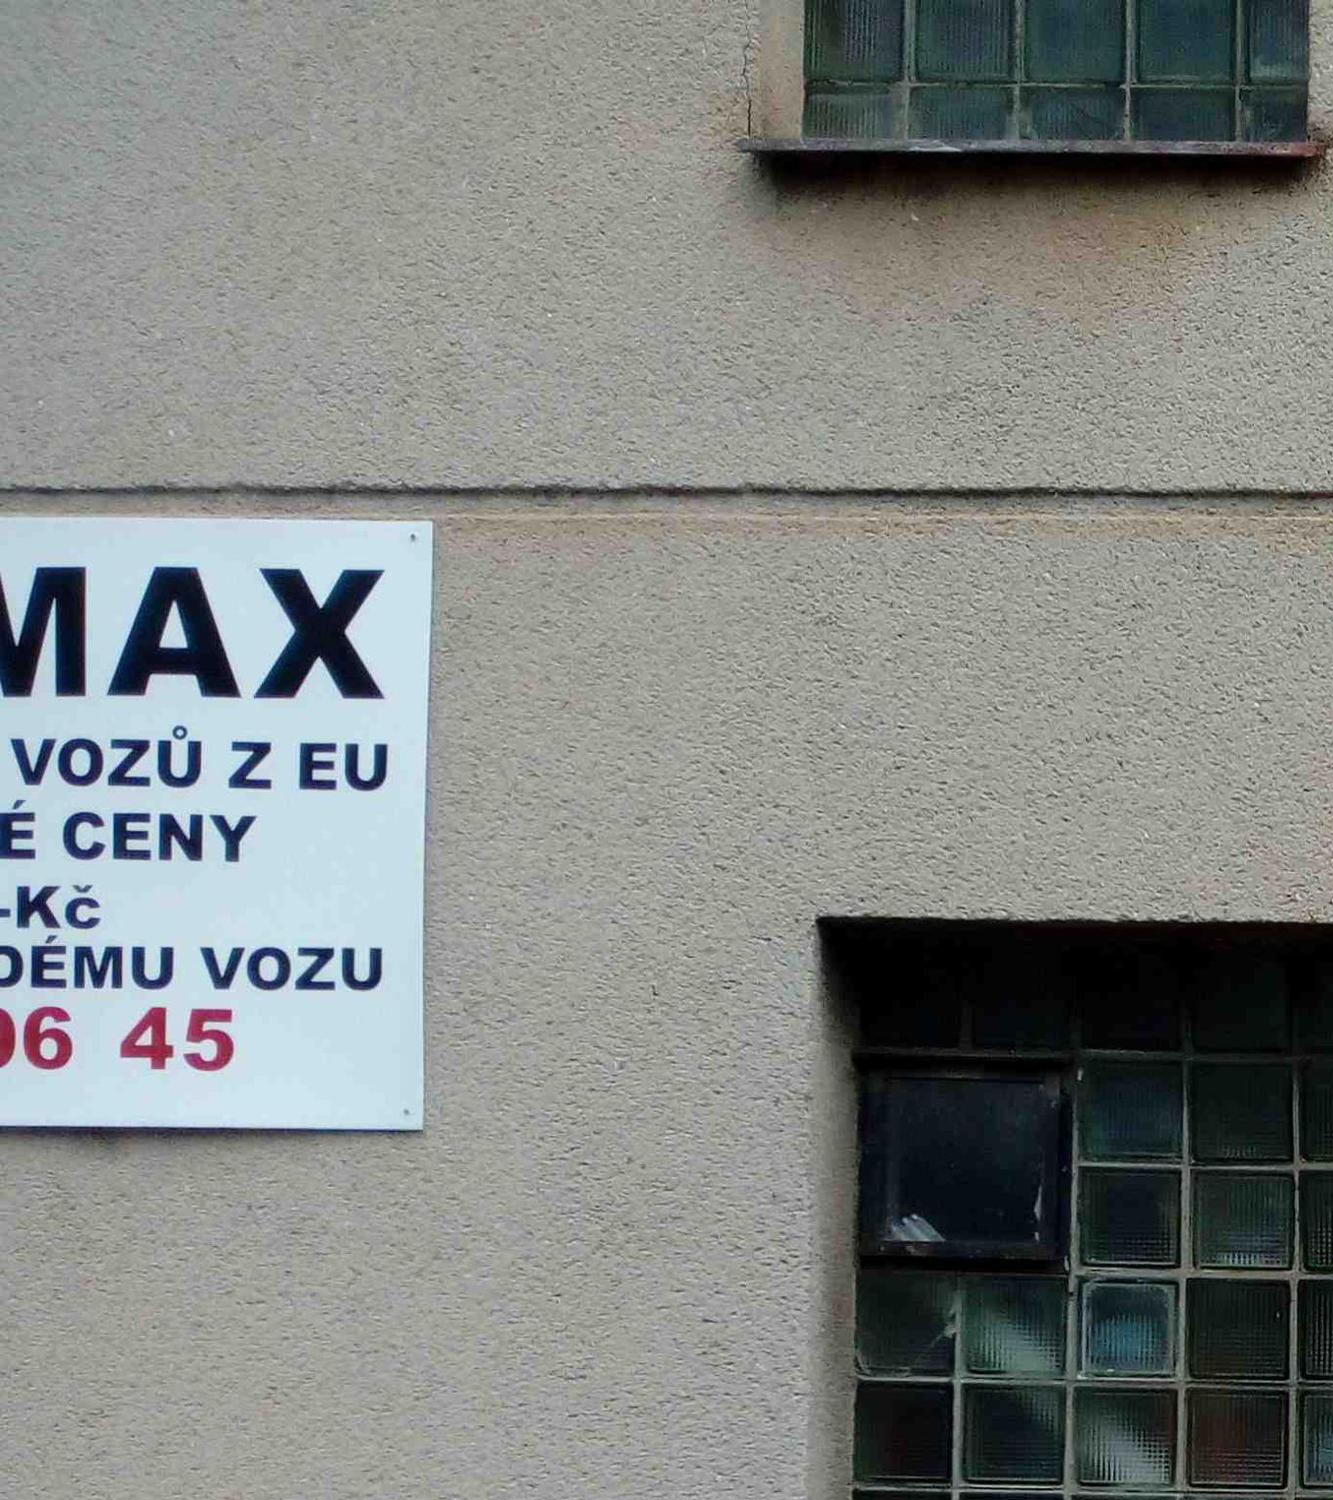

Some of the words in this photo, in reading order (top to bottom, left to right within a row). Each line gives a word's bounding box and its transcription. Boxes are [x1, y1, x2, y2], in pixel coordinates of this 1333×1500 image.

[11, 726, 201, 787] VOZŮ
[228, 741, 272, 789] Z
[299, 743, 388, 791] EU
[62, 811, 256, 862] CENY
[200, 947, 382, 990] VOZU
[120, 1006, 234, 1071] 45
